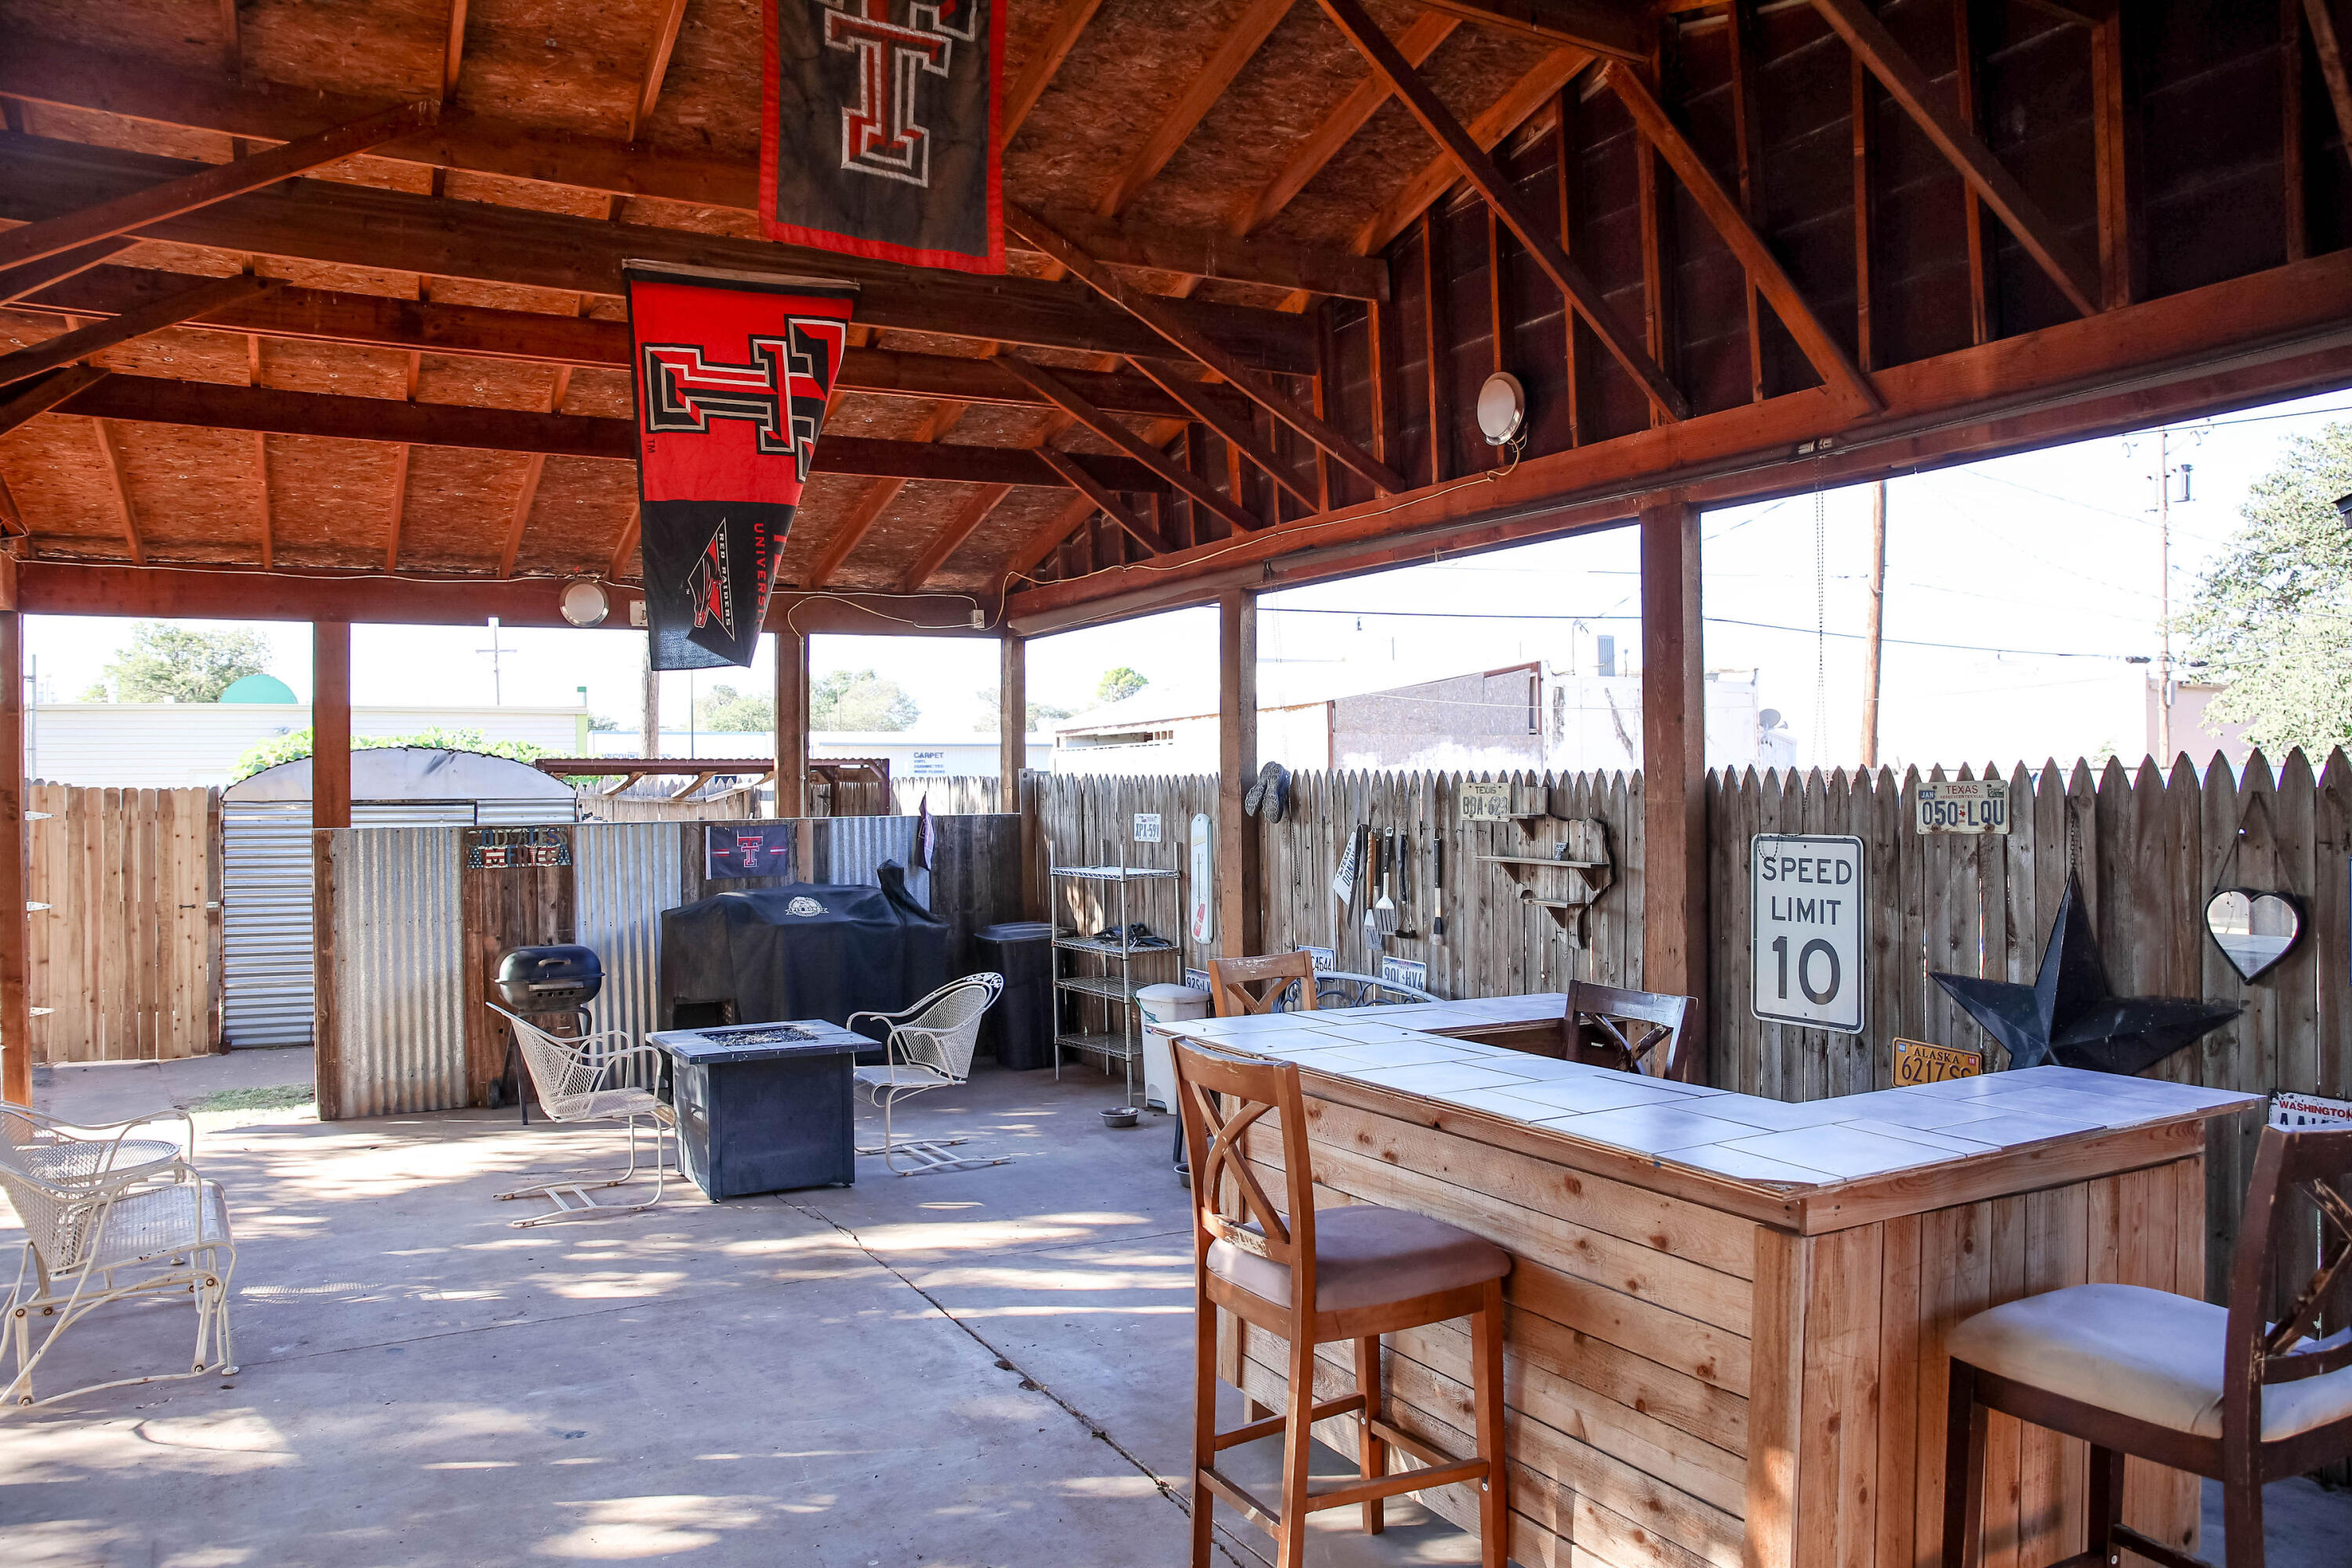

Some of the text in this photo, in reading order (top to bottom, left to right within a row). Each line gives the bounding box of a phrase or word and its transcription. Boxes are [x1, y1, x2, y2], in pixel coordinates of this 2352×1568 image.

[646, 439, 655, 453] TM
[717, 533, 731, 626] RED RAIDERS
[753, 523, 768, 634] UNIVERSI
[1475, 786, 1497, 794] TEXAS
[1945, 785, 1979, 794] TEXAS
[464, 827, 568, 847] GOD BLESS
[466, 844, 572, 869] AMERICA
[1341, 847, 1352, 870] TEXAS
[1762, 856, 1853, 885] SPEED
[1771, 895, 1842, 925] LIMIT
[1772, 935, 1841, 1005] 10
[1913, 1047, 1960, 1065] ALASKA
[2278, 1100, 2352, 1120] WASHINGTON
